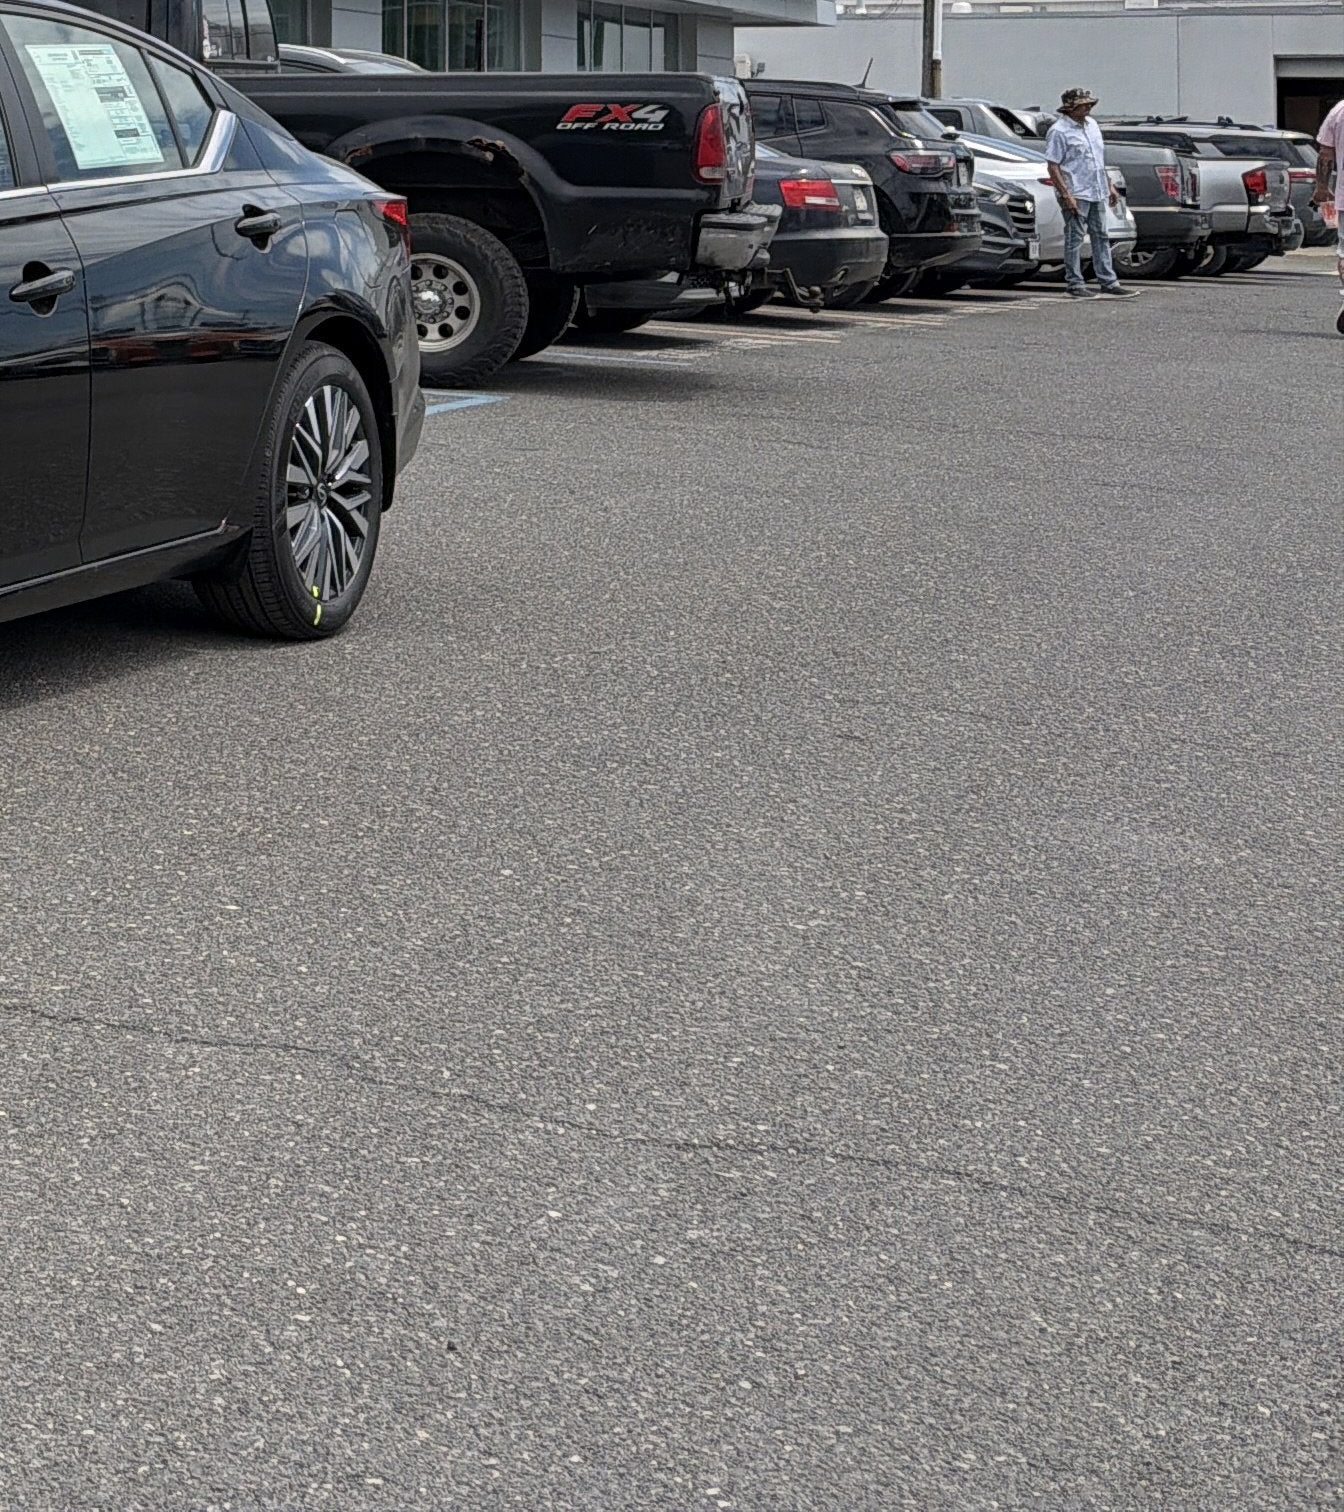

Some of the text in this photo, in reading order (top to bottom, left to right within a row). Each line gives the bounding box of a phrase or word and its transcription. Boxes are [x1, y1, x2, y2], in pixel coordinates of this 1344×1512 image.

[560, 103, 670, 123] FX4
[556, 122, 665, 131] OFF ROAD
